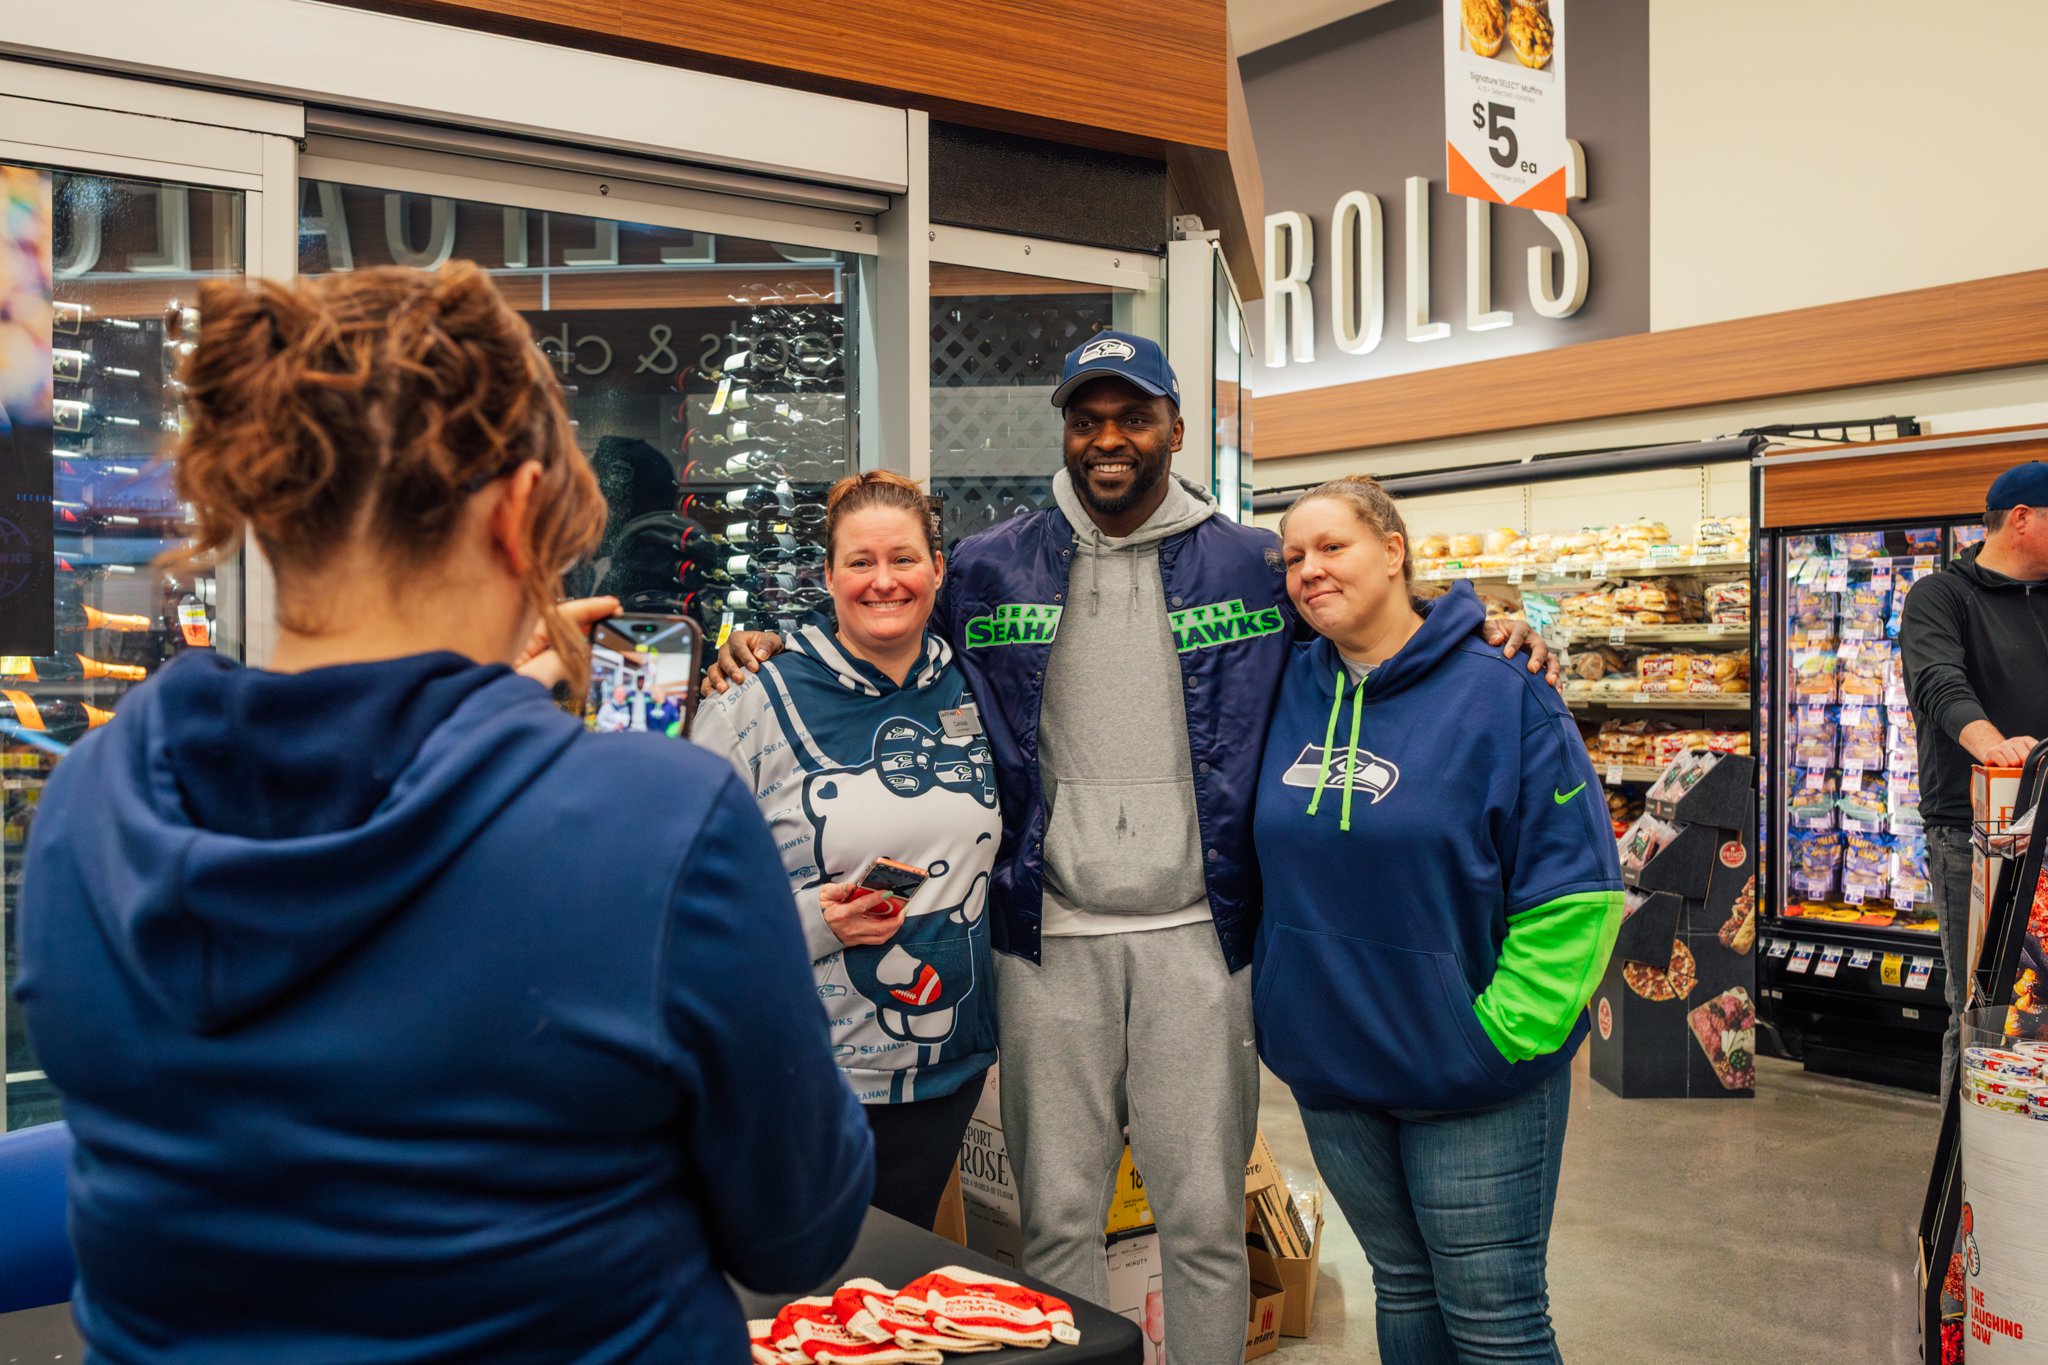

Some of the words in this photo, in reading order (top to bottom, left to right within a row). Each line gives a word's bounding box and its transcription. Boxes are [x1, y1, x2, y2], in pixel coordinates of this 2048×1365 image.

[1470, 71, 1498, 86] Signature
[1499, 79, 1520, 90] SELECT
[1521, 84, 1543, 96] Muffins
[1472, 100, 1518, 168] $5
[1521, 161, 1537, 175] ea
[1264, 138, 1590, 369] ROLLS
[960, 1142, 1009, 1187] ROSÉ
[1125, 1258, 1148, 1269] MINUTY
[1971, 1285, 1985, 1308] THE
[1971, 1303, 2023, 1340] LAUGHING
[1971, 1321, 1991, 1346] COW
